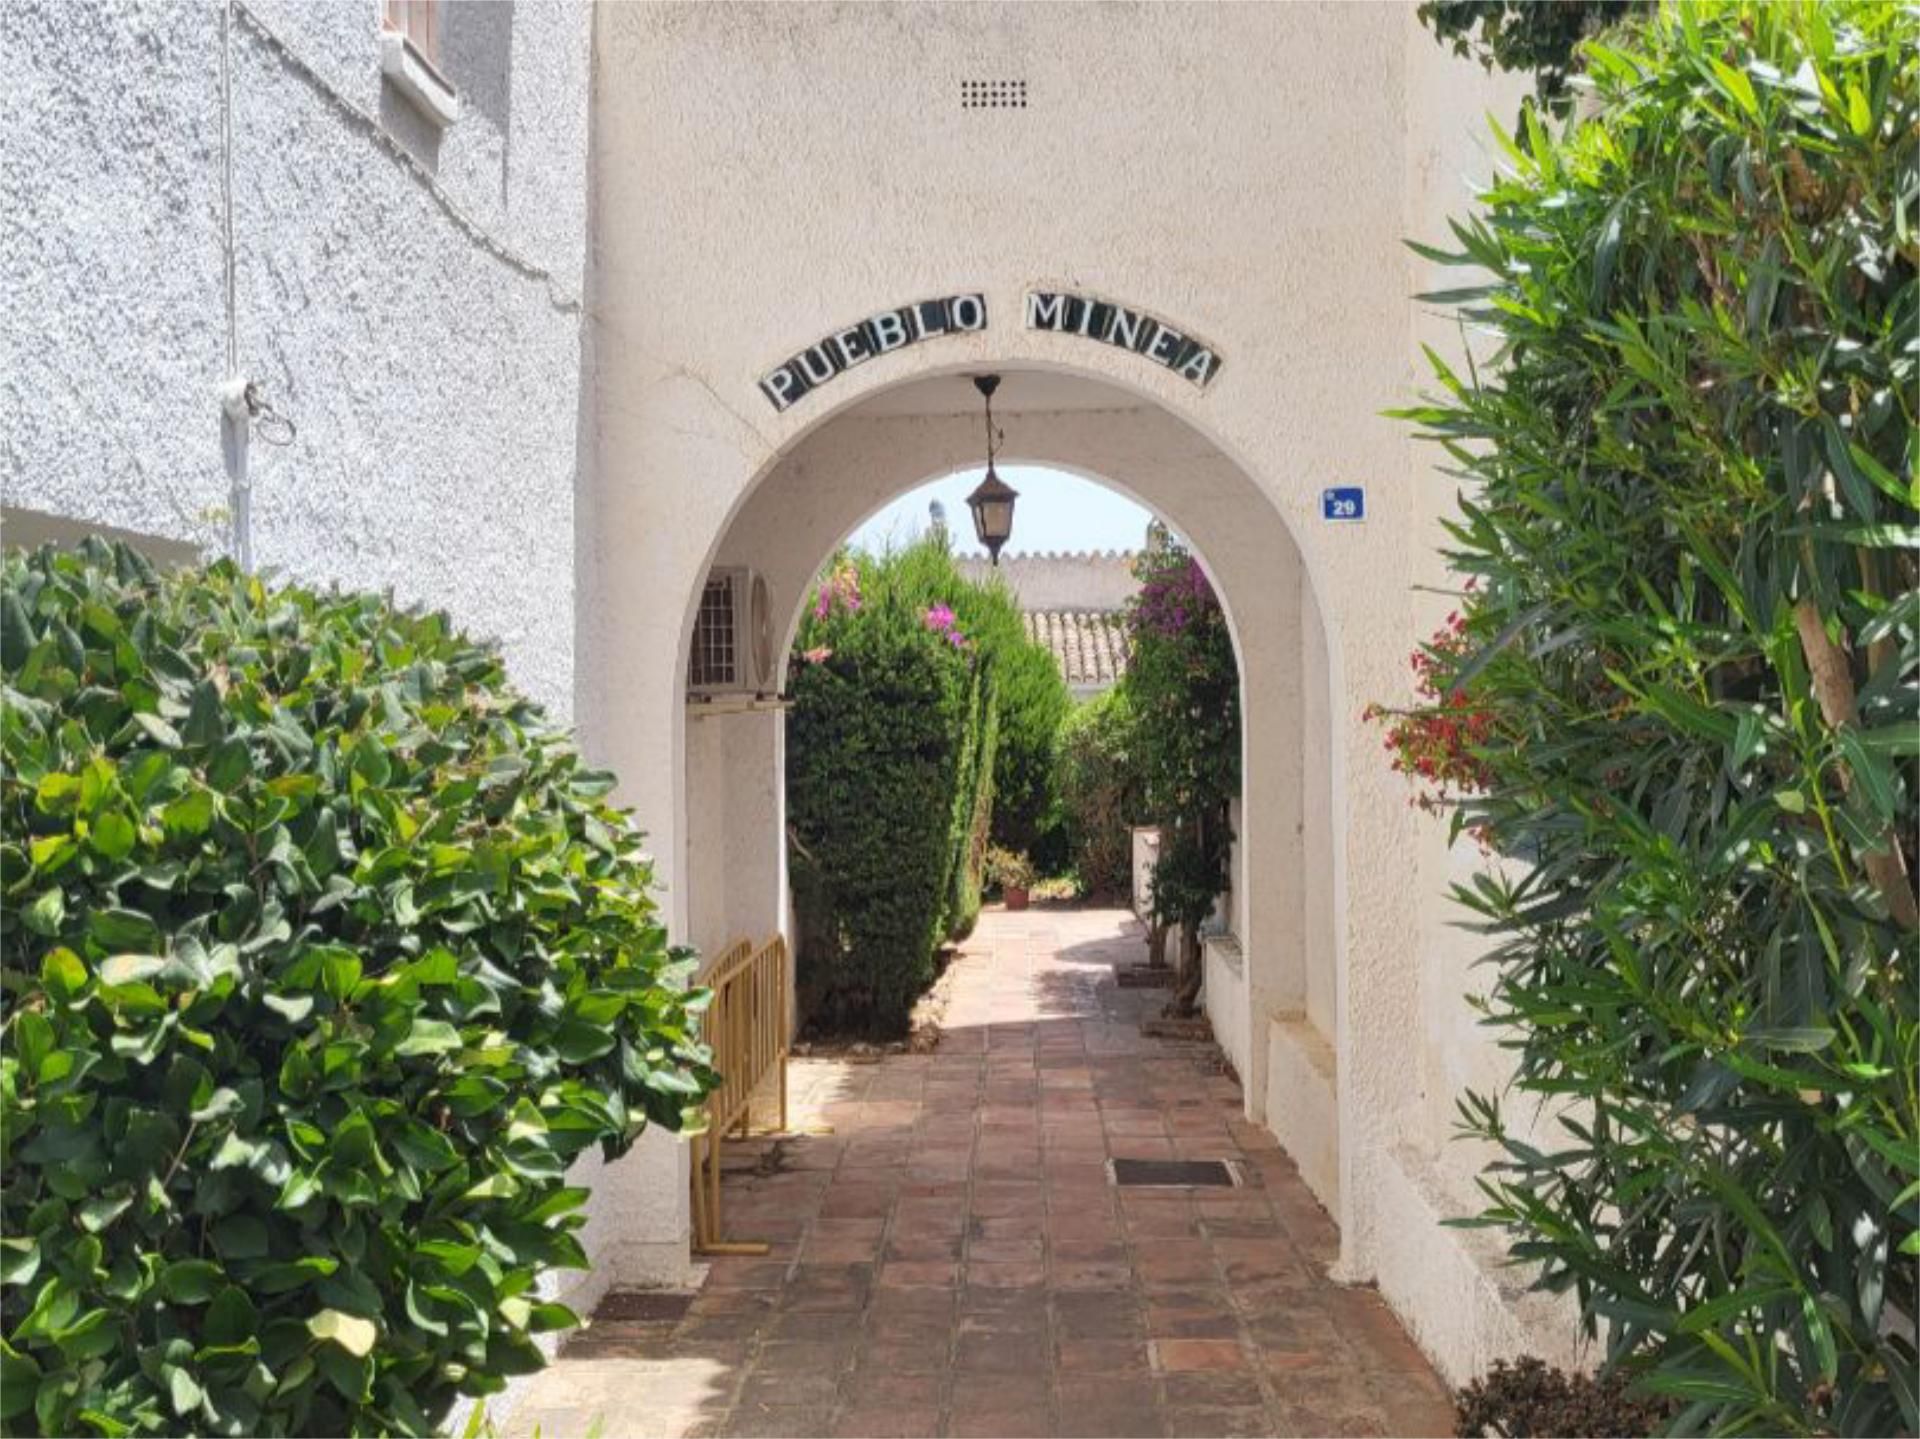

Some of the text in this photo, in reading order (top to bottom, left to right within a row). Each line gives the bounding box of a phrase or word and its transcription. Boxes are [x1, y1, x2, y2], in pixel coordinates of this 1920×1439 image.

[762, 294, 1213, 409] PUEBLO MINEA
[1333, 499, 1356, 516] 29
